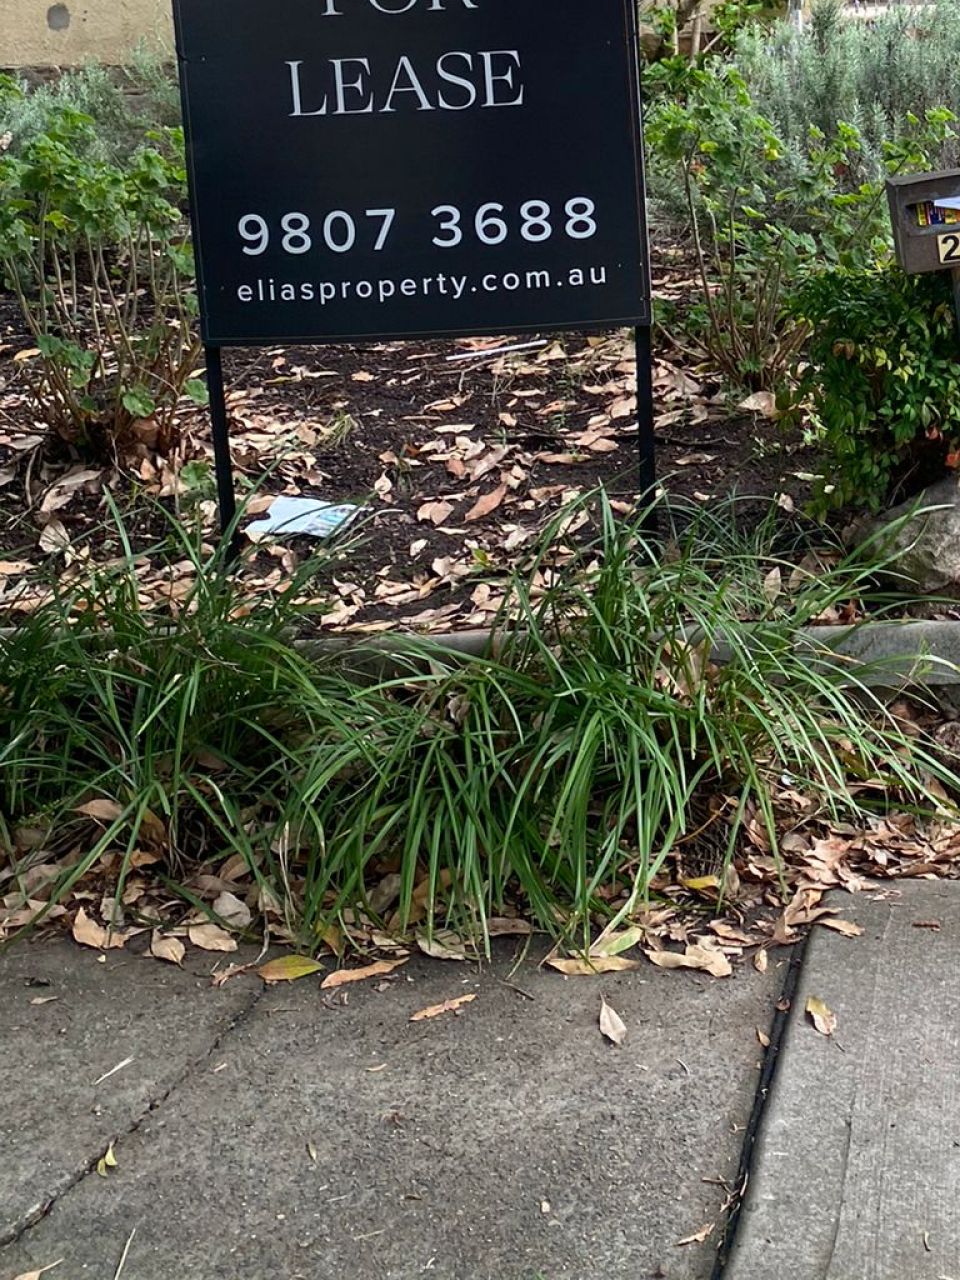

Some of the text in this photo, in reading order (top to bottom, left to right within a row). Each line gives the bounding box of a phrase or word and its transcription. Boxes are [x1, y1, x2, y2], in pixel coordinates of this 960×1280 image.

[284, 51, 523, 116] LEASE
[239, 197, 596, 255] 9807 3688
[238, 267, 605, 304] eliasproperty.com.au
